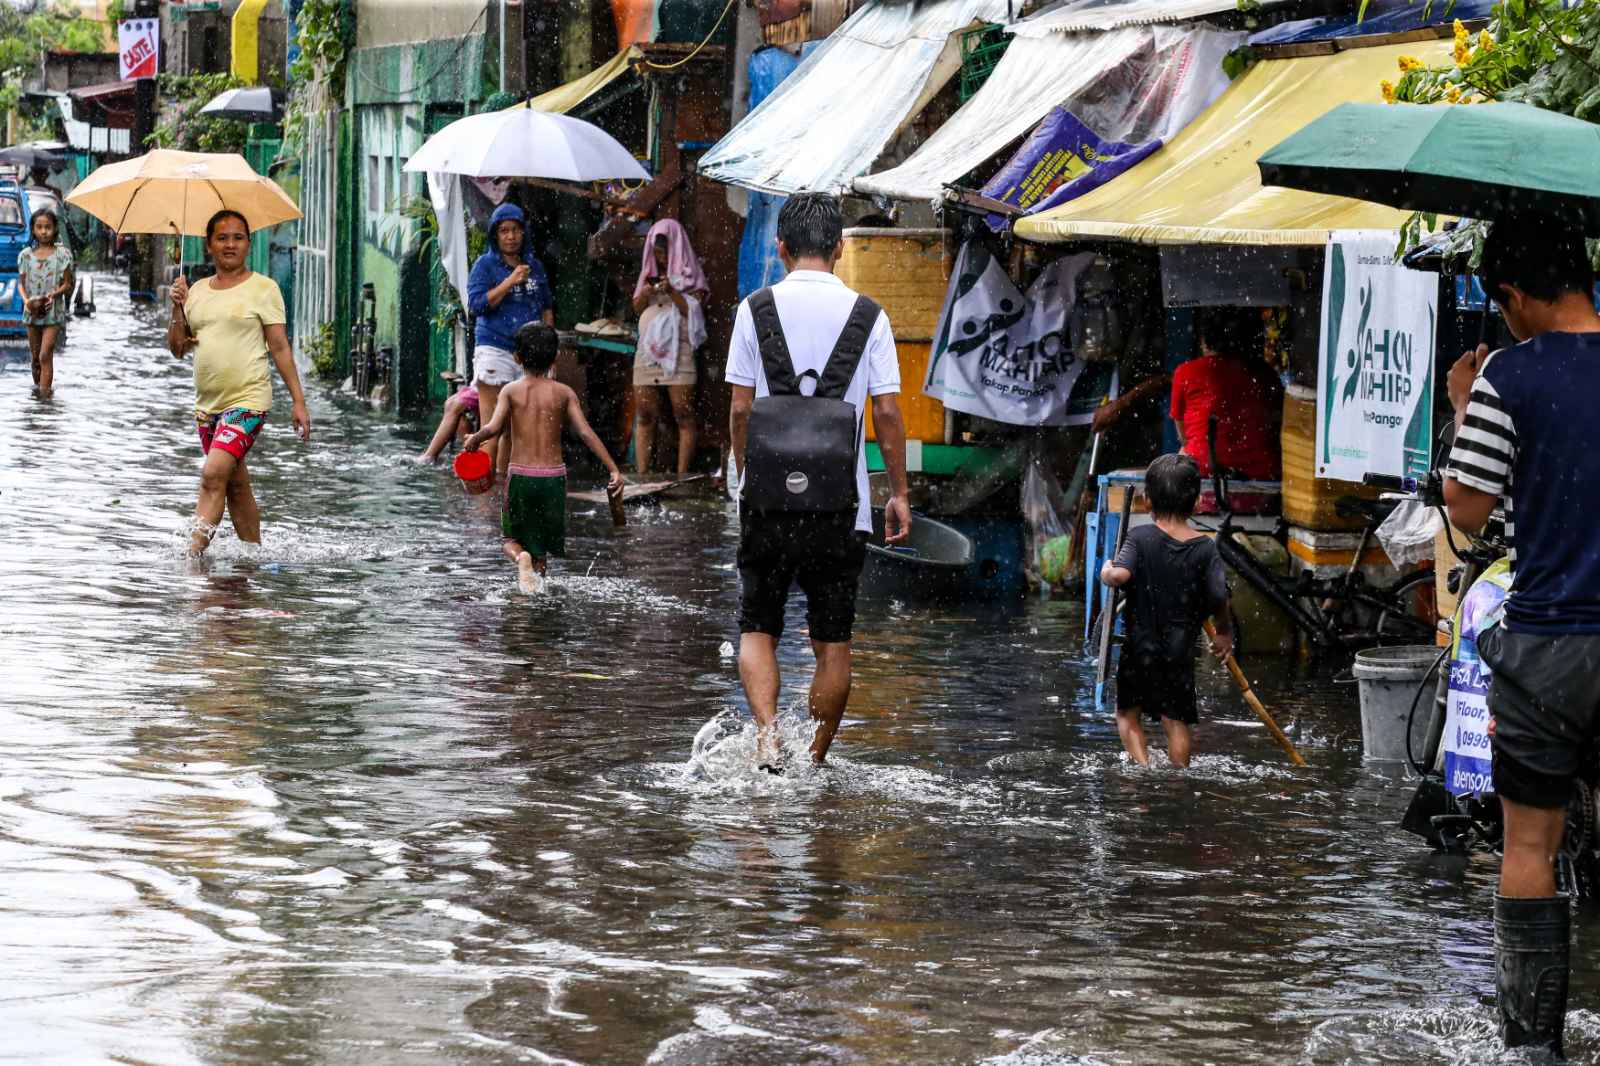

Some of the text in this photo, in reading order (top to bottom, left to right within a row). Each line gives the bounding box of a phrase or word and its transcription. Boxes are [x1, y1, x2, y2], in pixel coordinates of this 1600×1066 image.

[980, 374, 1009, 394] Yakap
[1360, 371, 1412, 406] MAHIRP
[1462, 730, 1489, 749] 0998
